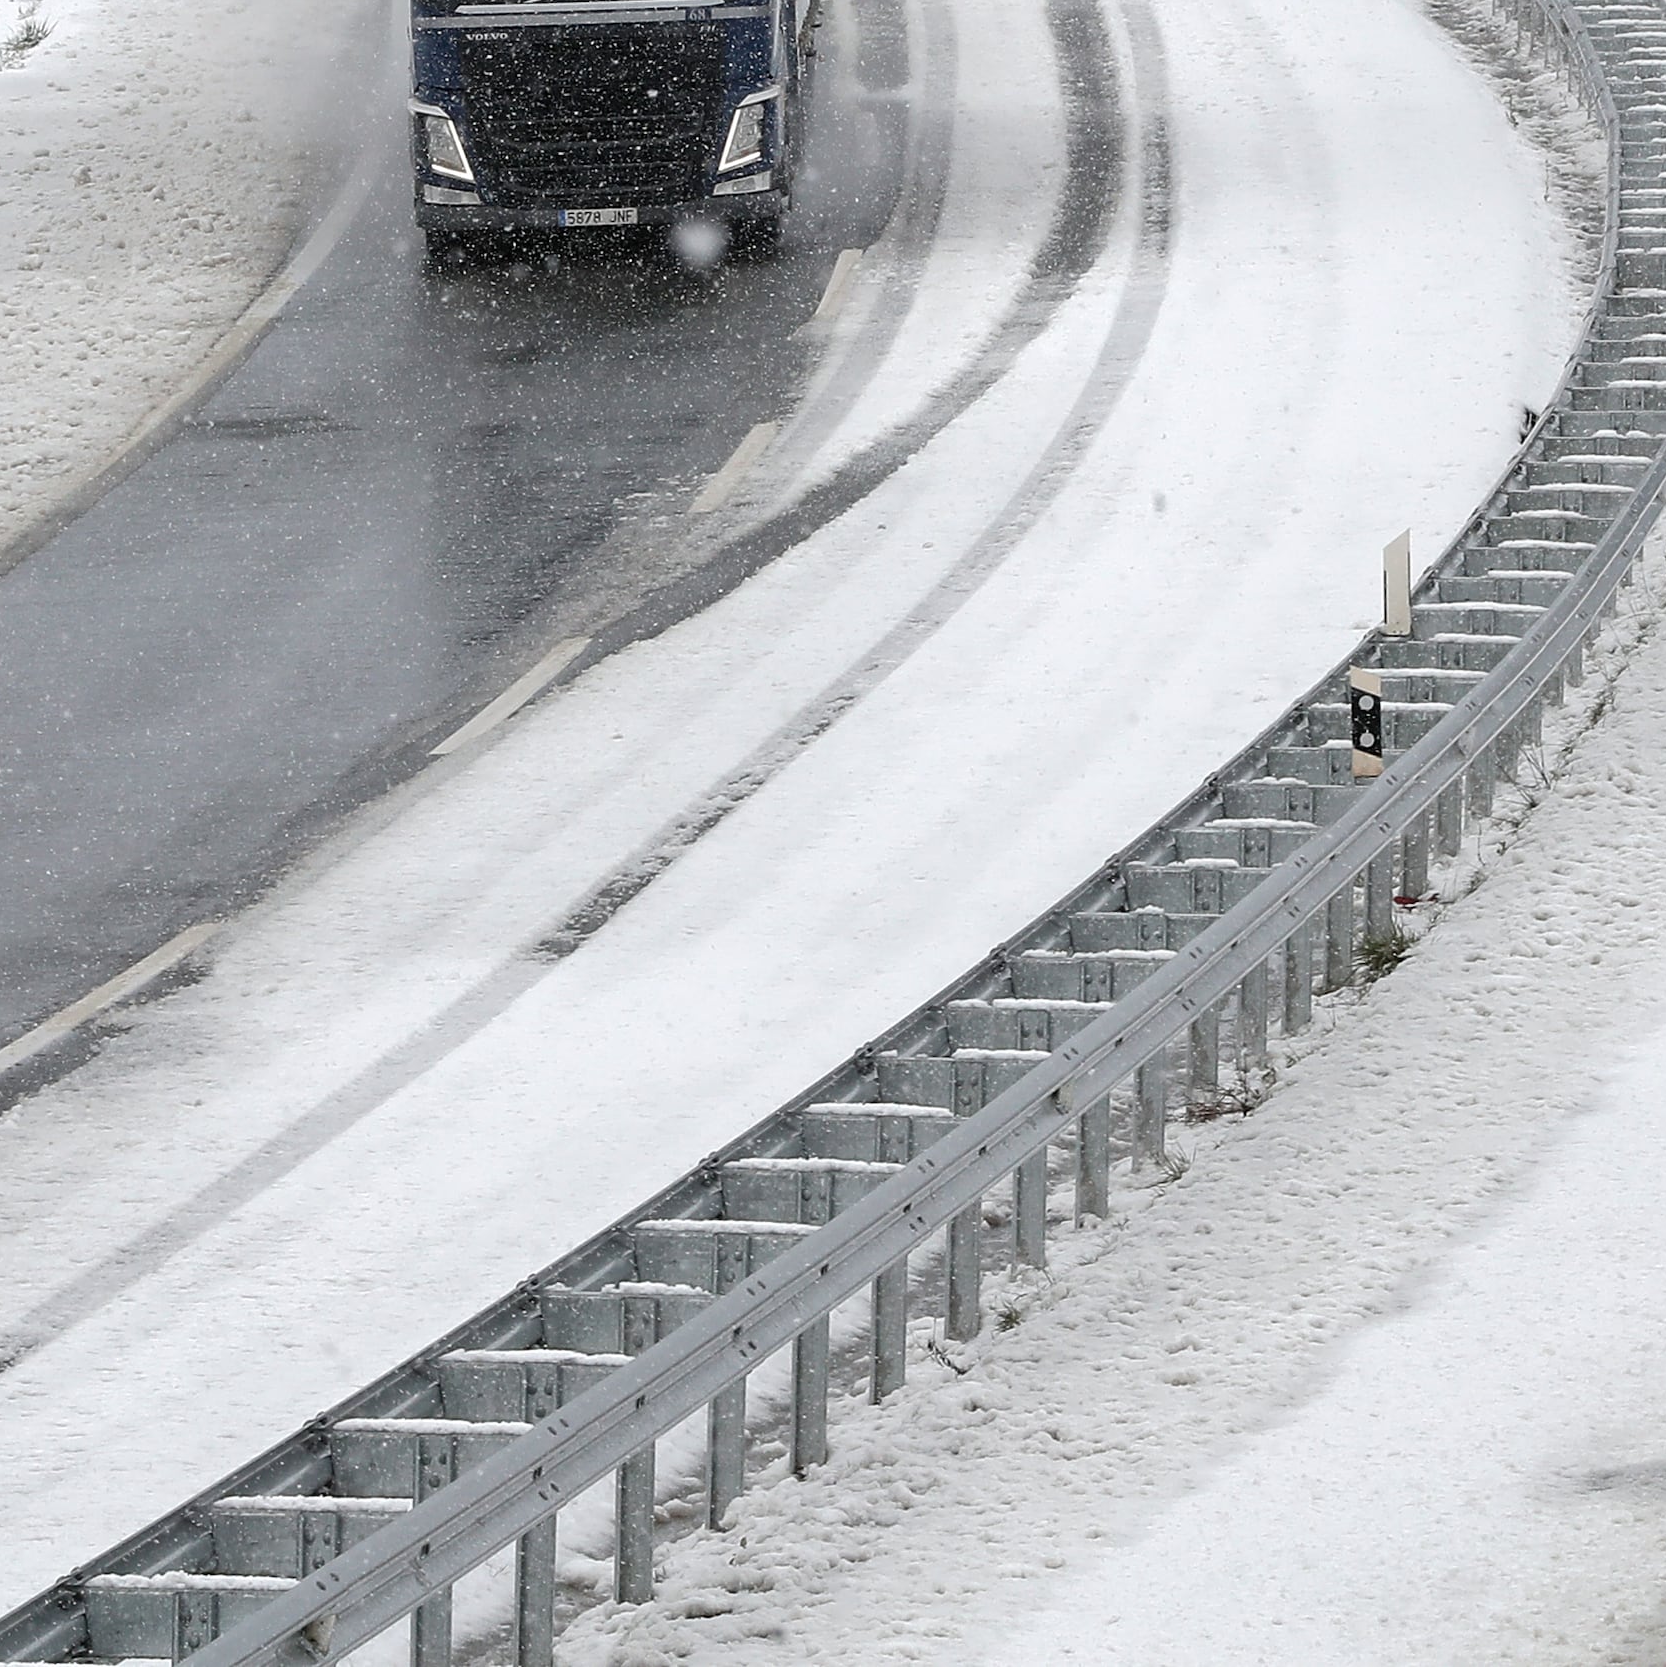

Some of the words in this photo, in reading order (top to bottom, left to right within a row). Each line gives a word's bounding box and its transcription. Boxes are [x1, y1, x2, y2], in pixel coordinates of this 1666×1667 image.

[689, 8, 706, 22] 68
[465, 32, 509, 41] VOLVO
[567, 210, 601, 225] 5878
[609, 209, 634, 223] JNF
